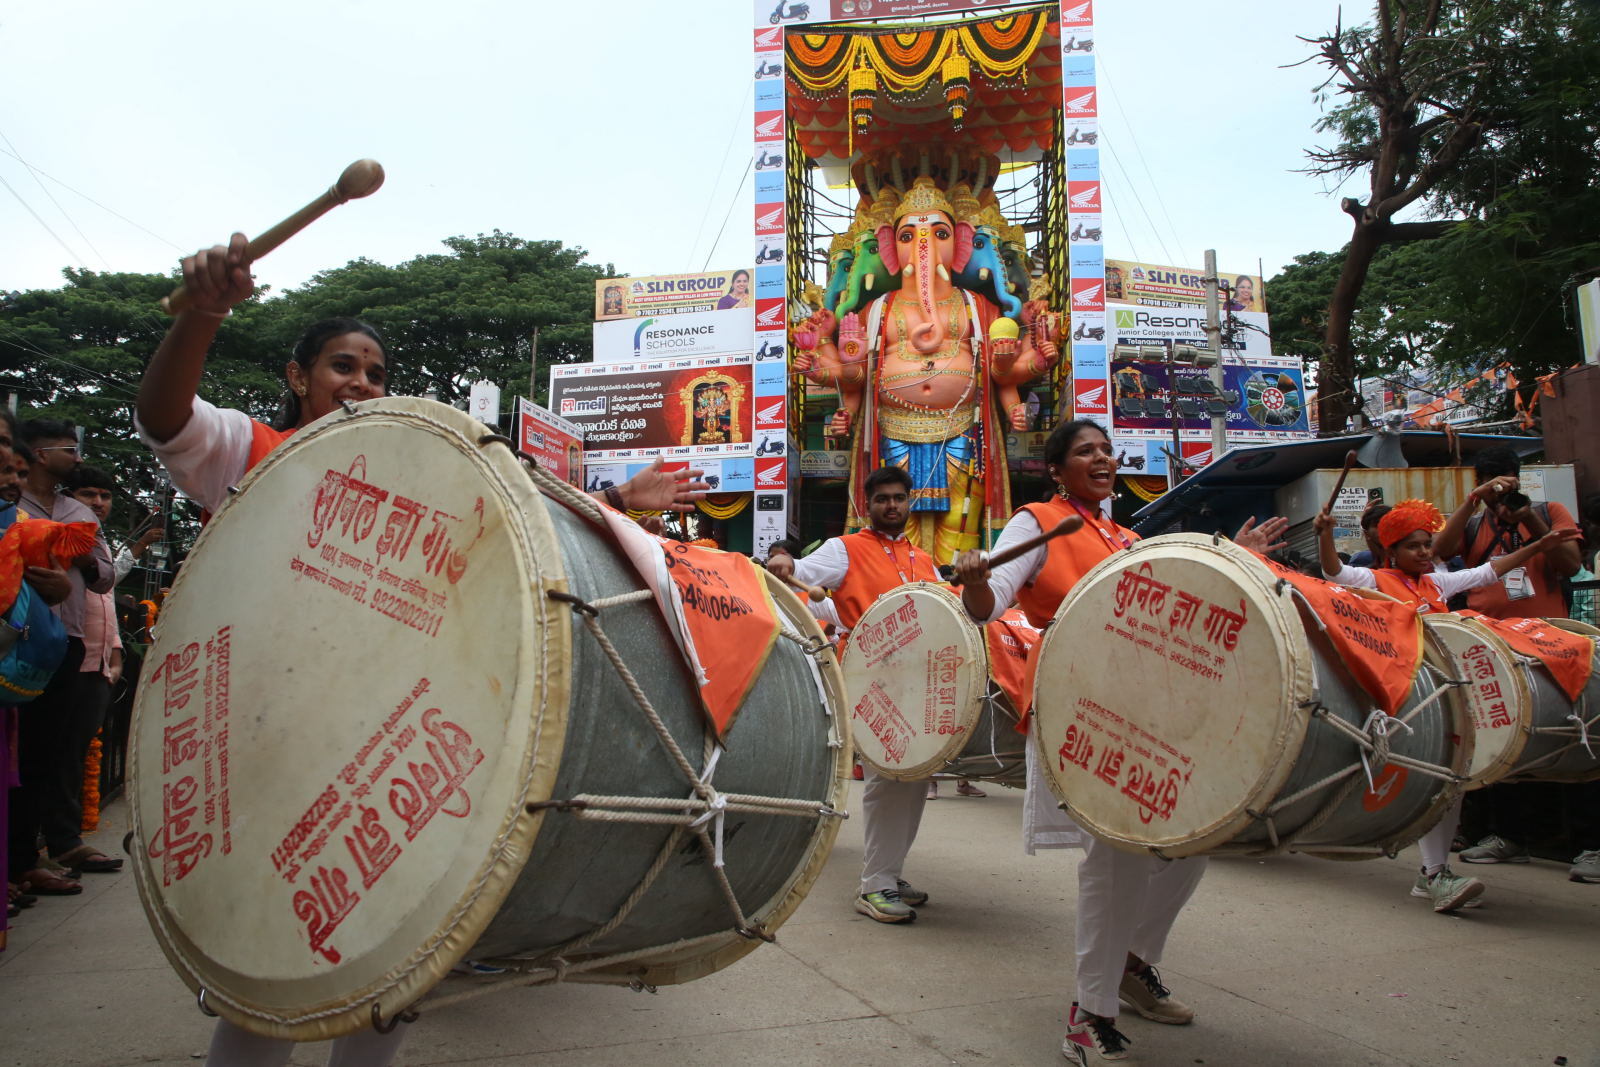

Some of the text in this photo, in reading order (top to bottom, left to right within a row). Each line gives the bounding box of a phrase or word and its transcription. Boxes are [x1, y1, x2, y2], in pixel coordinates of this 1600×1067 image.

[647, 280, 675, 293] SLN
[677, 277, 726, 291] GROUP
[1148, 270, 1177, 284] SLN
[646, 326, 714, 339] RESONANCE
[646, 338, 695, 350] SCHOOLS
[1142, 329, 1174, 337] Colleges
[564, 368, 578, 376] meil
[592, 367, 606, 375] meil
[619, 365, 634, 373] meil
[648, 363, 663, 371] meil
[676, 360, 692, 368] meil
[705, 358, 720, 366] meil
[577, 397, 606, 411] meil
[586, 431, 634, 443] శుభాకాంక్షలు
[620, 418, 647, 430] చవితి
[616, 449, 631, 457] meil
[645, 448, 660, 456] meil
[675, 447, 689, 455] meil
[704, 445, 719, 453] meil
[734, 443, 749, 451] meil
[320, 543, 339, 567] 1024,
[1113, 562, 1172, 618] सुनिल
[1203, 599, 1247, 651] गाडे
[215, 624, 232, 719] 9822902811
[934, 645, 964, 683] सुनिल
[1169, 650, 1223, 682] 9822902811
[151, 642, 200, 717] गाडे
[937, 709, 966, 736] गाडे
[391, 724, 417, 753] 1024,
[1058, 724, 1094, 772] गाडे
[388, 708, 485, 842] सुनिल
[1121, 763, 1181, 824] सुनिल
[204, 794, 216, 825] 1024,
[148, 775, 213, 887] सुनिल
[270, 784, 340, 872] 9822902811
[293, 865, 361, 965] गाडे
